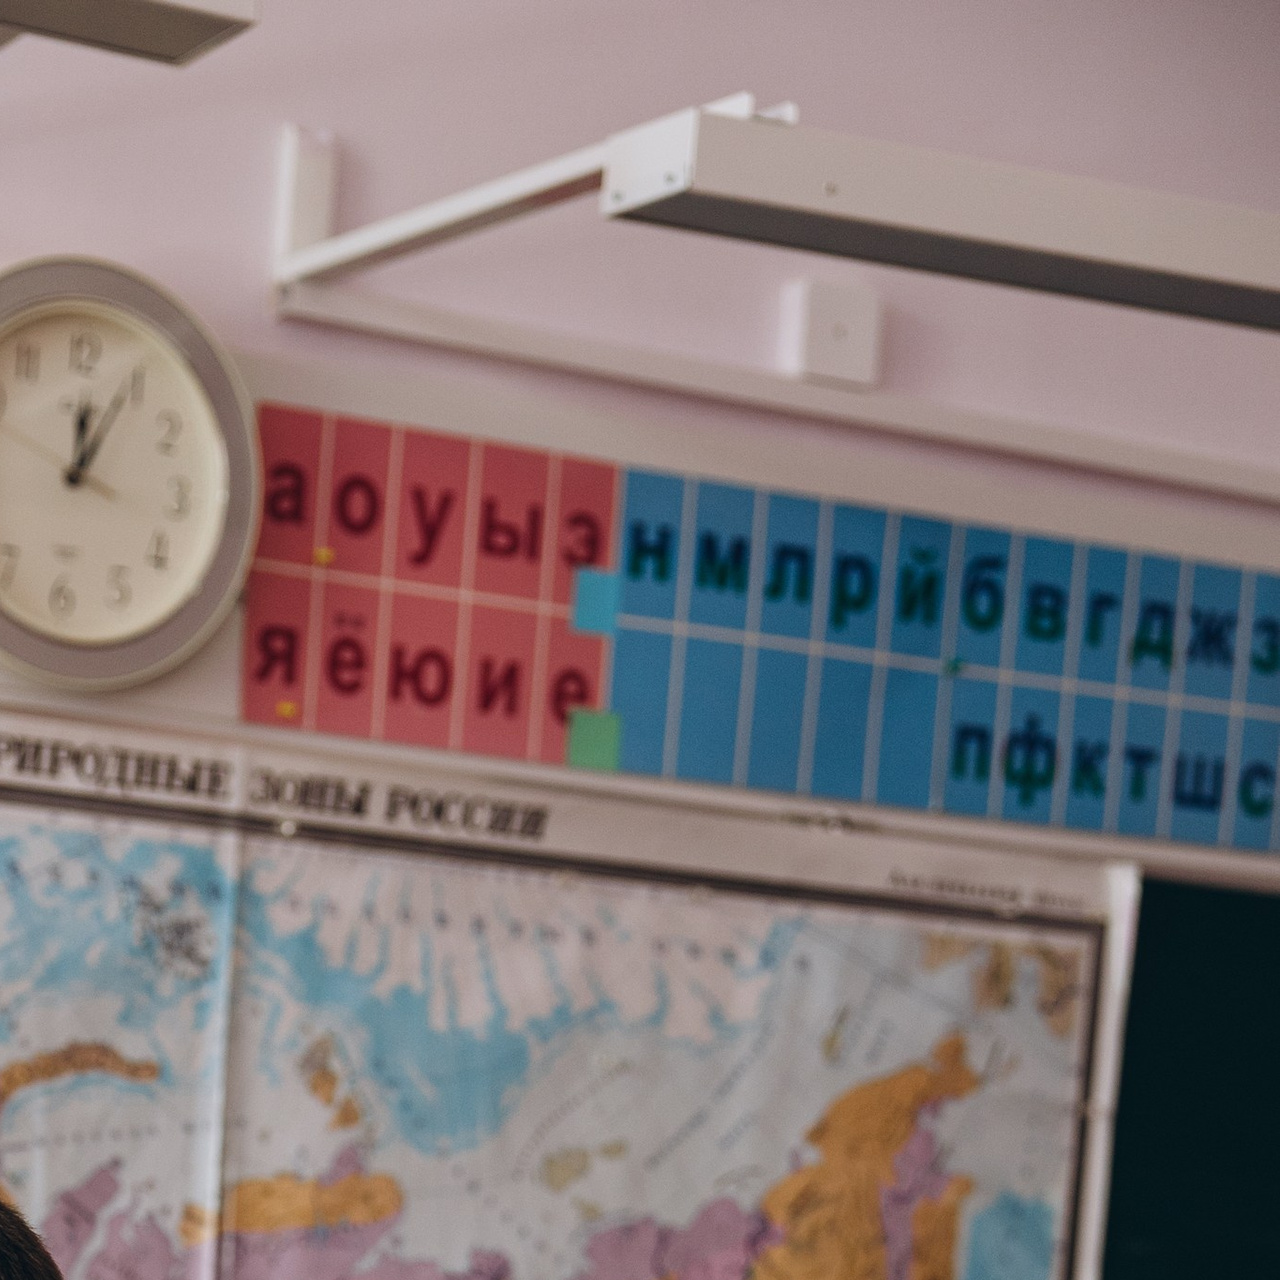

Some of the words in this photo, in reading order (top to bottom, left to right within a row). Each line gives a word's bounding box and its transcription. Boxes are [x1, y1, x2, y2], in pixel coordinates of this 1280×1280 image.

[15, 342, 40, 384] 11
[68, 331, 103, 377] 12
[154, 408, 183, 456] 2
[165, 475, 191, 521] 3
[145, 529, 171, 571] 4
[48, 574, 76, 620] 6
[247, 766, 372, 819] ЗОНЫ
[385, 783, 551, 842] РОССИИ
